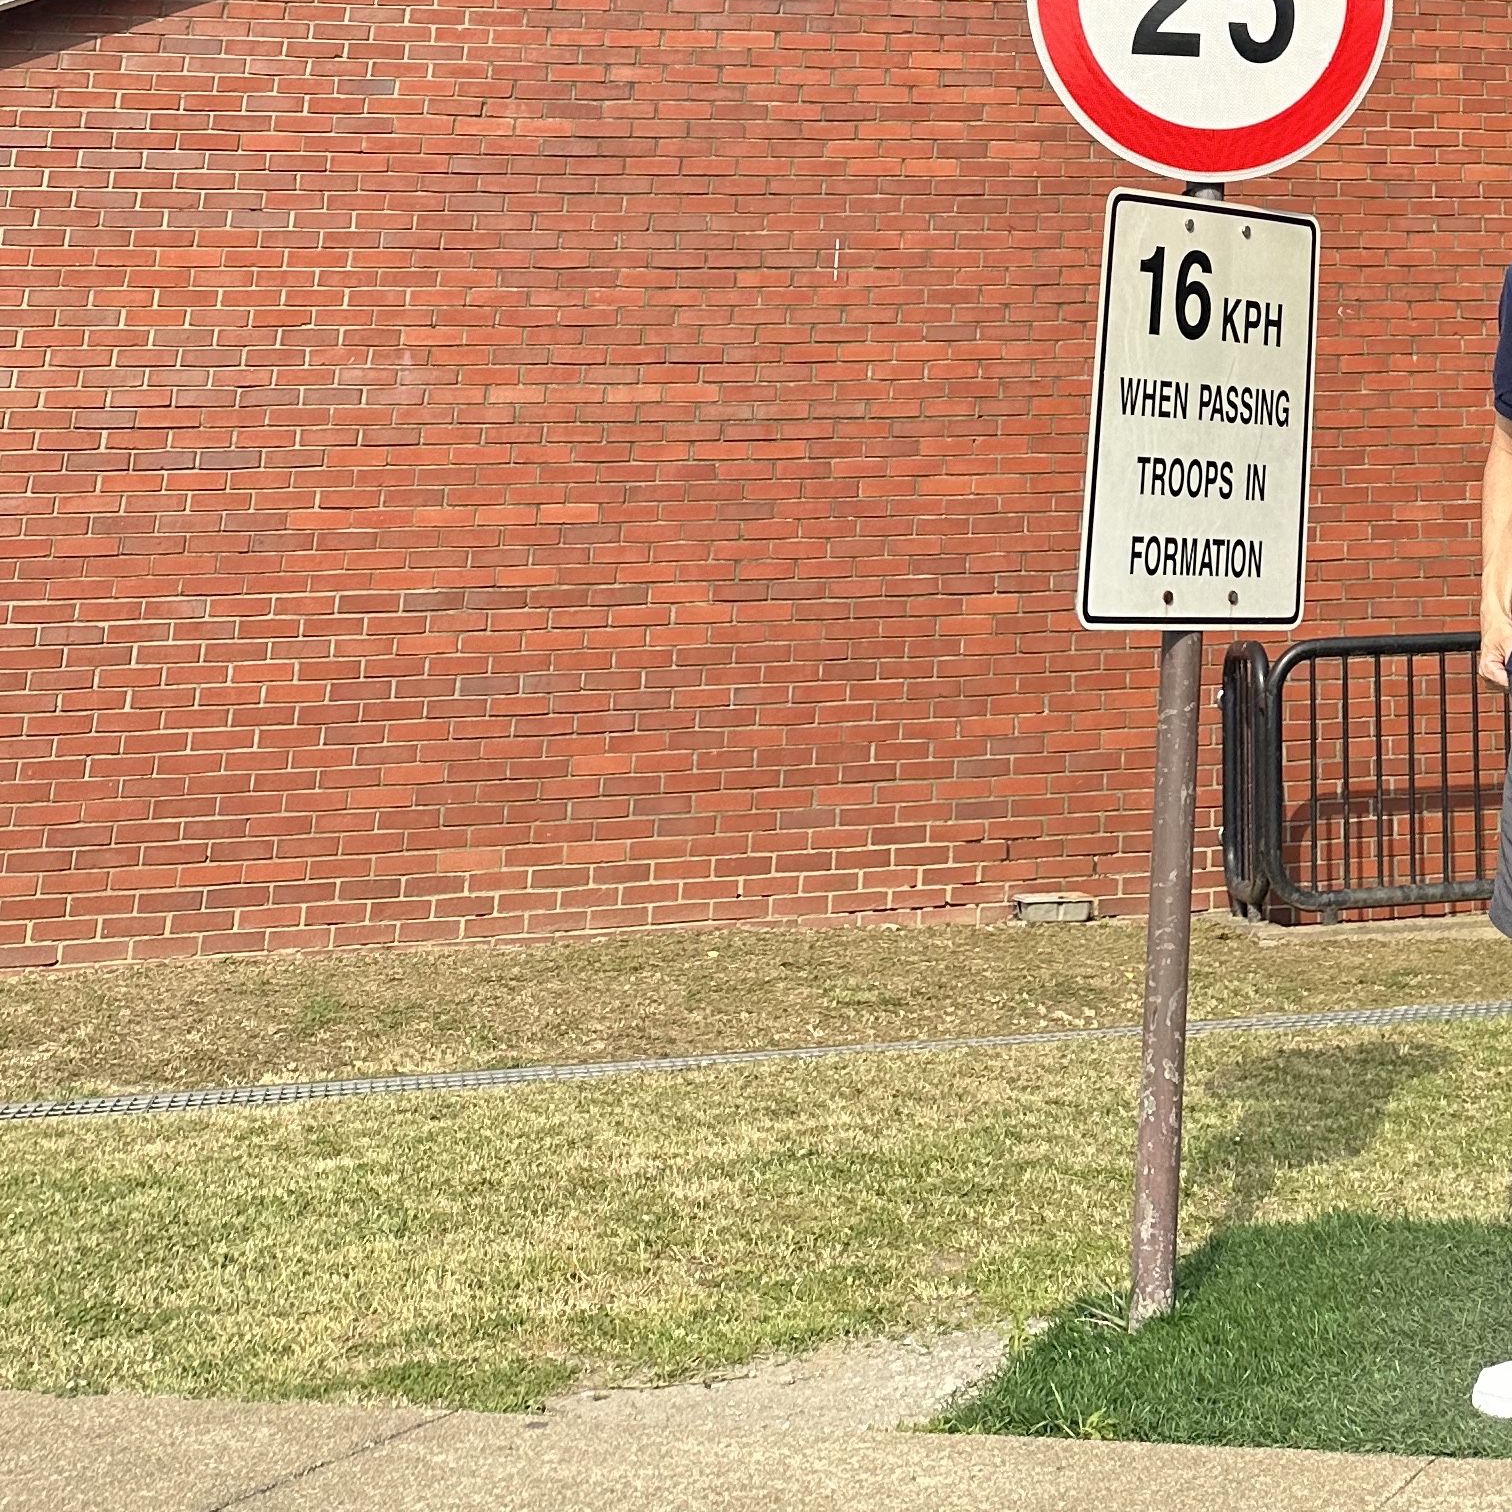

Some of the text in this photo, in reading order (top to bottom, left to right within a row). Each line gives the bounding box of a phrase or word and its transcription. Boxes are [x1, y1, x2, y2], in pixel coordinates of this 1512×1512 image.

[1139, 245, 1284, 348] 16 KPH
[1120, 377, 1290, 428] WHEN PASSING
[1136, 456, 1267, 502] TROOPS IN
[1129, 535, 1263, 579] FORMATION
